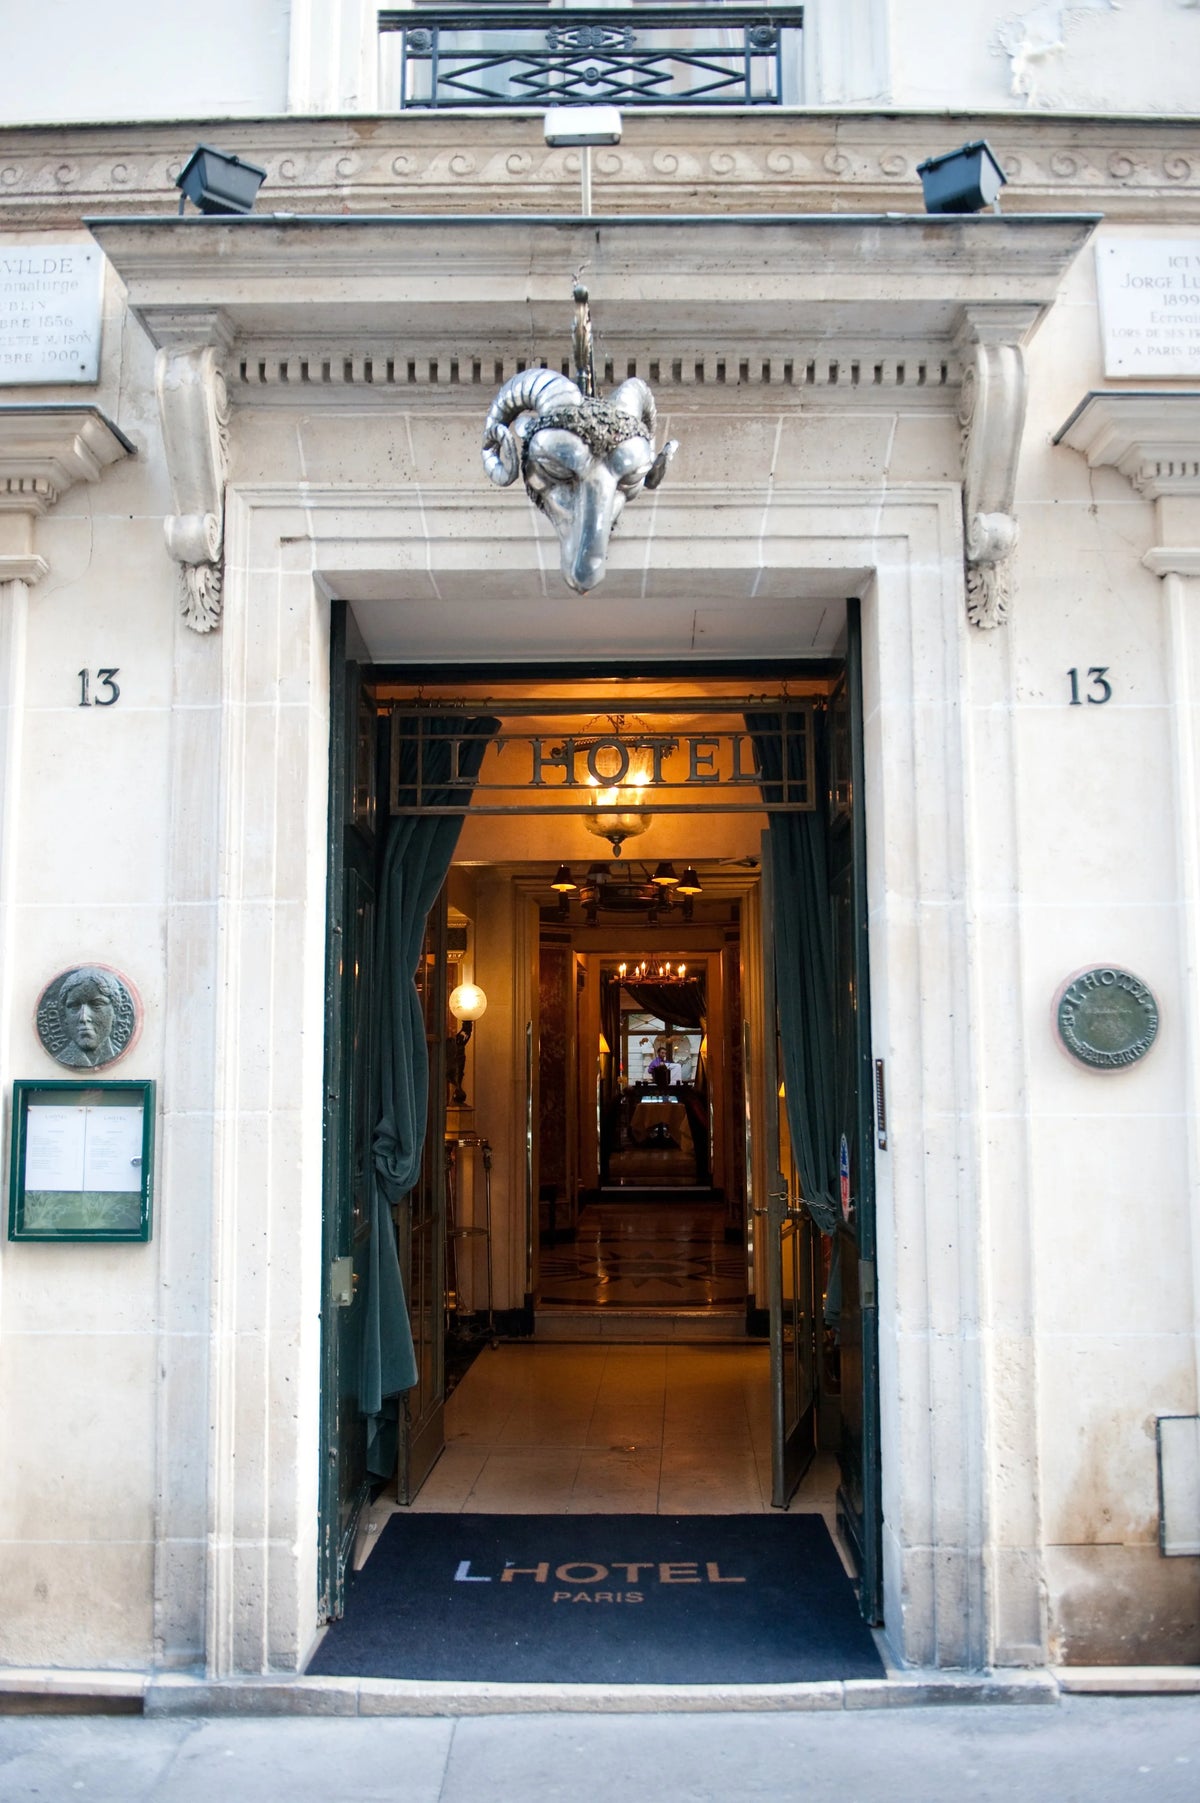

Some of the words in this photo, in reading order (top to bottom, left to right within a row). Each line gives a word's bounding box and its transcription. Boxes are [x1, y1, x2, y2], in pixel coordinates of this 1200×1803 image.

[1150, 311, 1200, 324] Ecrivai
[78, 668, 121, 707] 13
[1066, 666, 1112, 705] 13
[552, 1591, 645, 1604] PARIS
